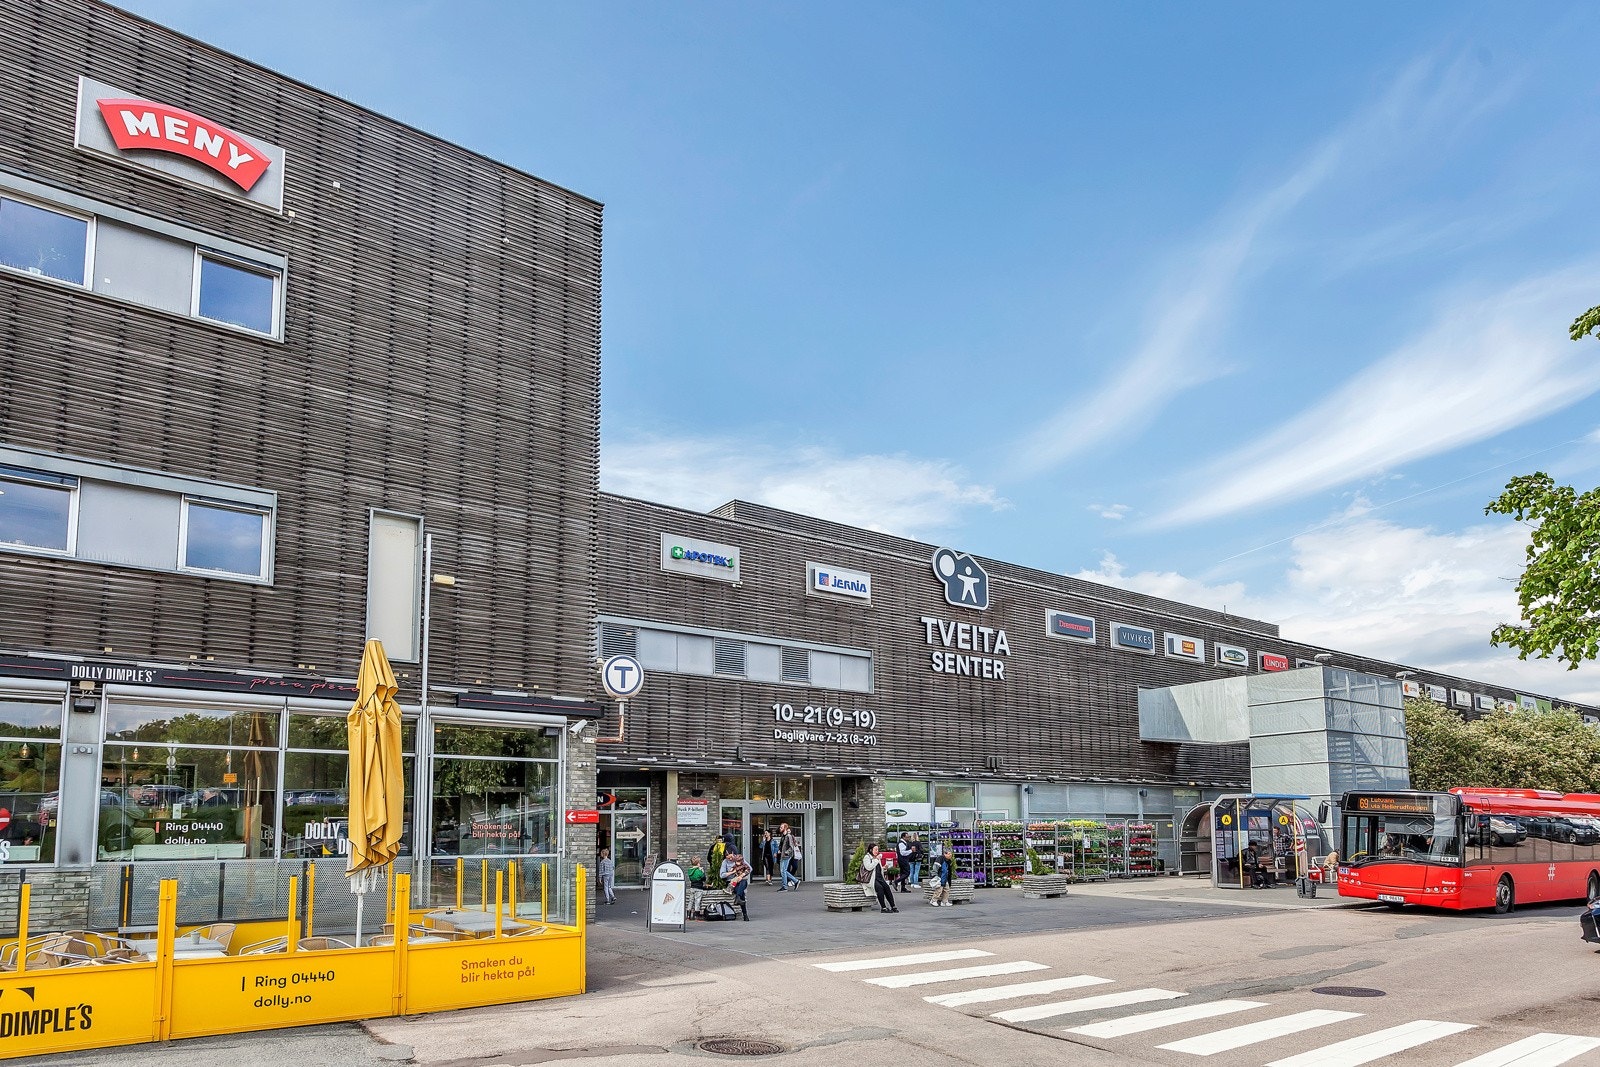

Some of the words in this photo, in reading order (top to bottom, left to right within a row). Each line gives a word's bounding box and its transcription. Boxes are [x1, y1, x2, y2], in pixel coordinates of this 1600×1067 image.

[119, 110, 253, 170] MENY
[921, 616, 1012, 656] TVEITA
[1122, 632, 1152, 645] VIVIKES
[931, 651, 1005, 680] SENTER
[1265, 658, 1287, 669] LINDEX
[72, 665, 103, 680] DOLLY
[614, 665, 633, 689] T
[774, 729, 824, 743] Dagligvare
[767, 799, 823, 810] Velkommen
[1360, 798, 1369, 809] 69
[165, 822, 189, 833] Ring
[191, 822, 224, 831] 04440
[304, 822, 340, 840] DOLLY
[472, 822, 500, 831] Smaken
[164, 836, 207, 846] dolly.no
[472, 830, 484, 838] blir
[486, 830, 507, 838] hekta
[461, 958, 506, 970] Smaken
[509, 955, 523, 966] du
[255, 975, 287, 988] Ring
[291, 970, 335, 984] 04440
[461, 972, 480, 983] blir
[483, 969, 514, 981] hekta
[518, 966, 535, 980] på!
[254, 995, 312, 1008] dolly.no
